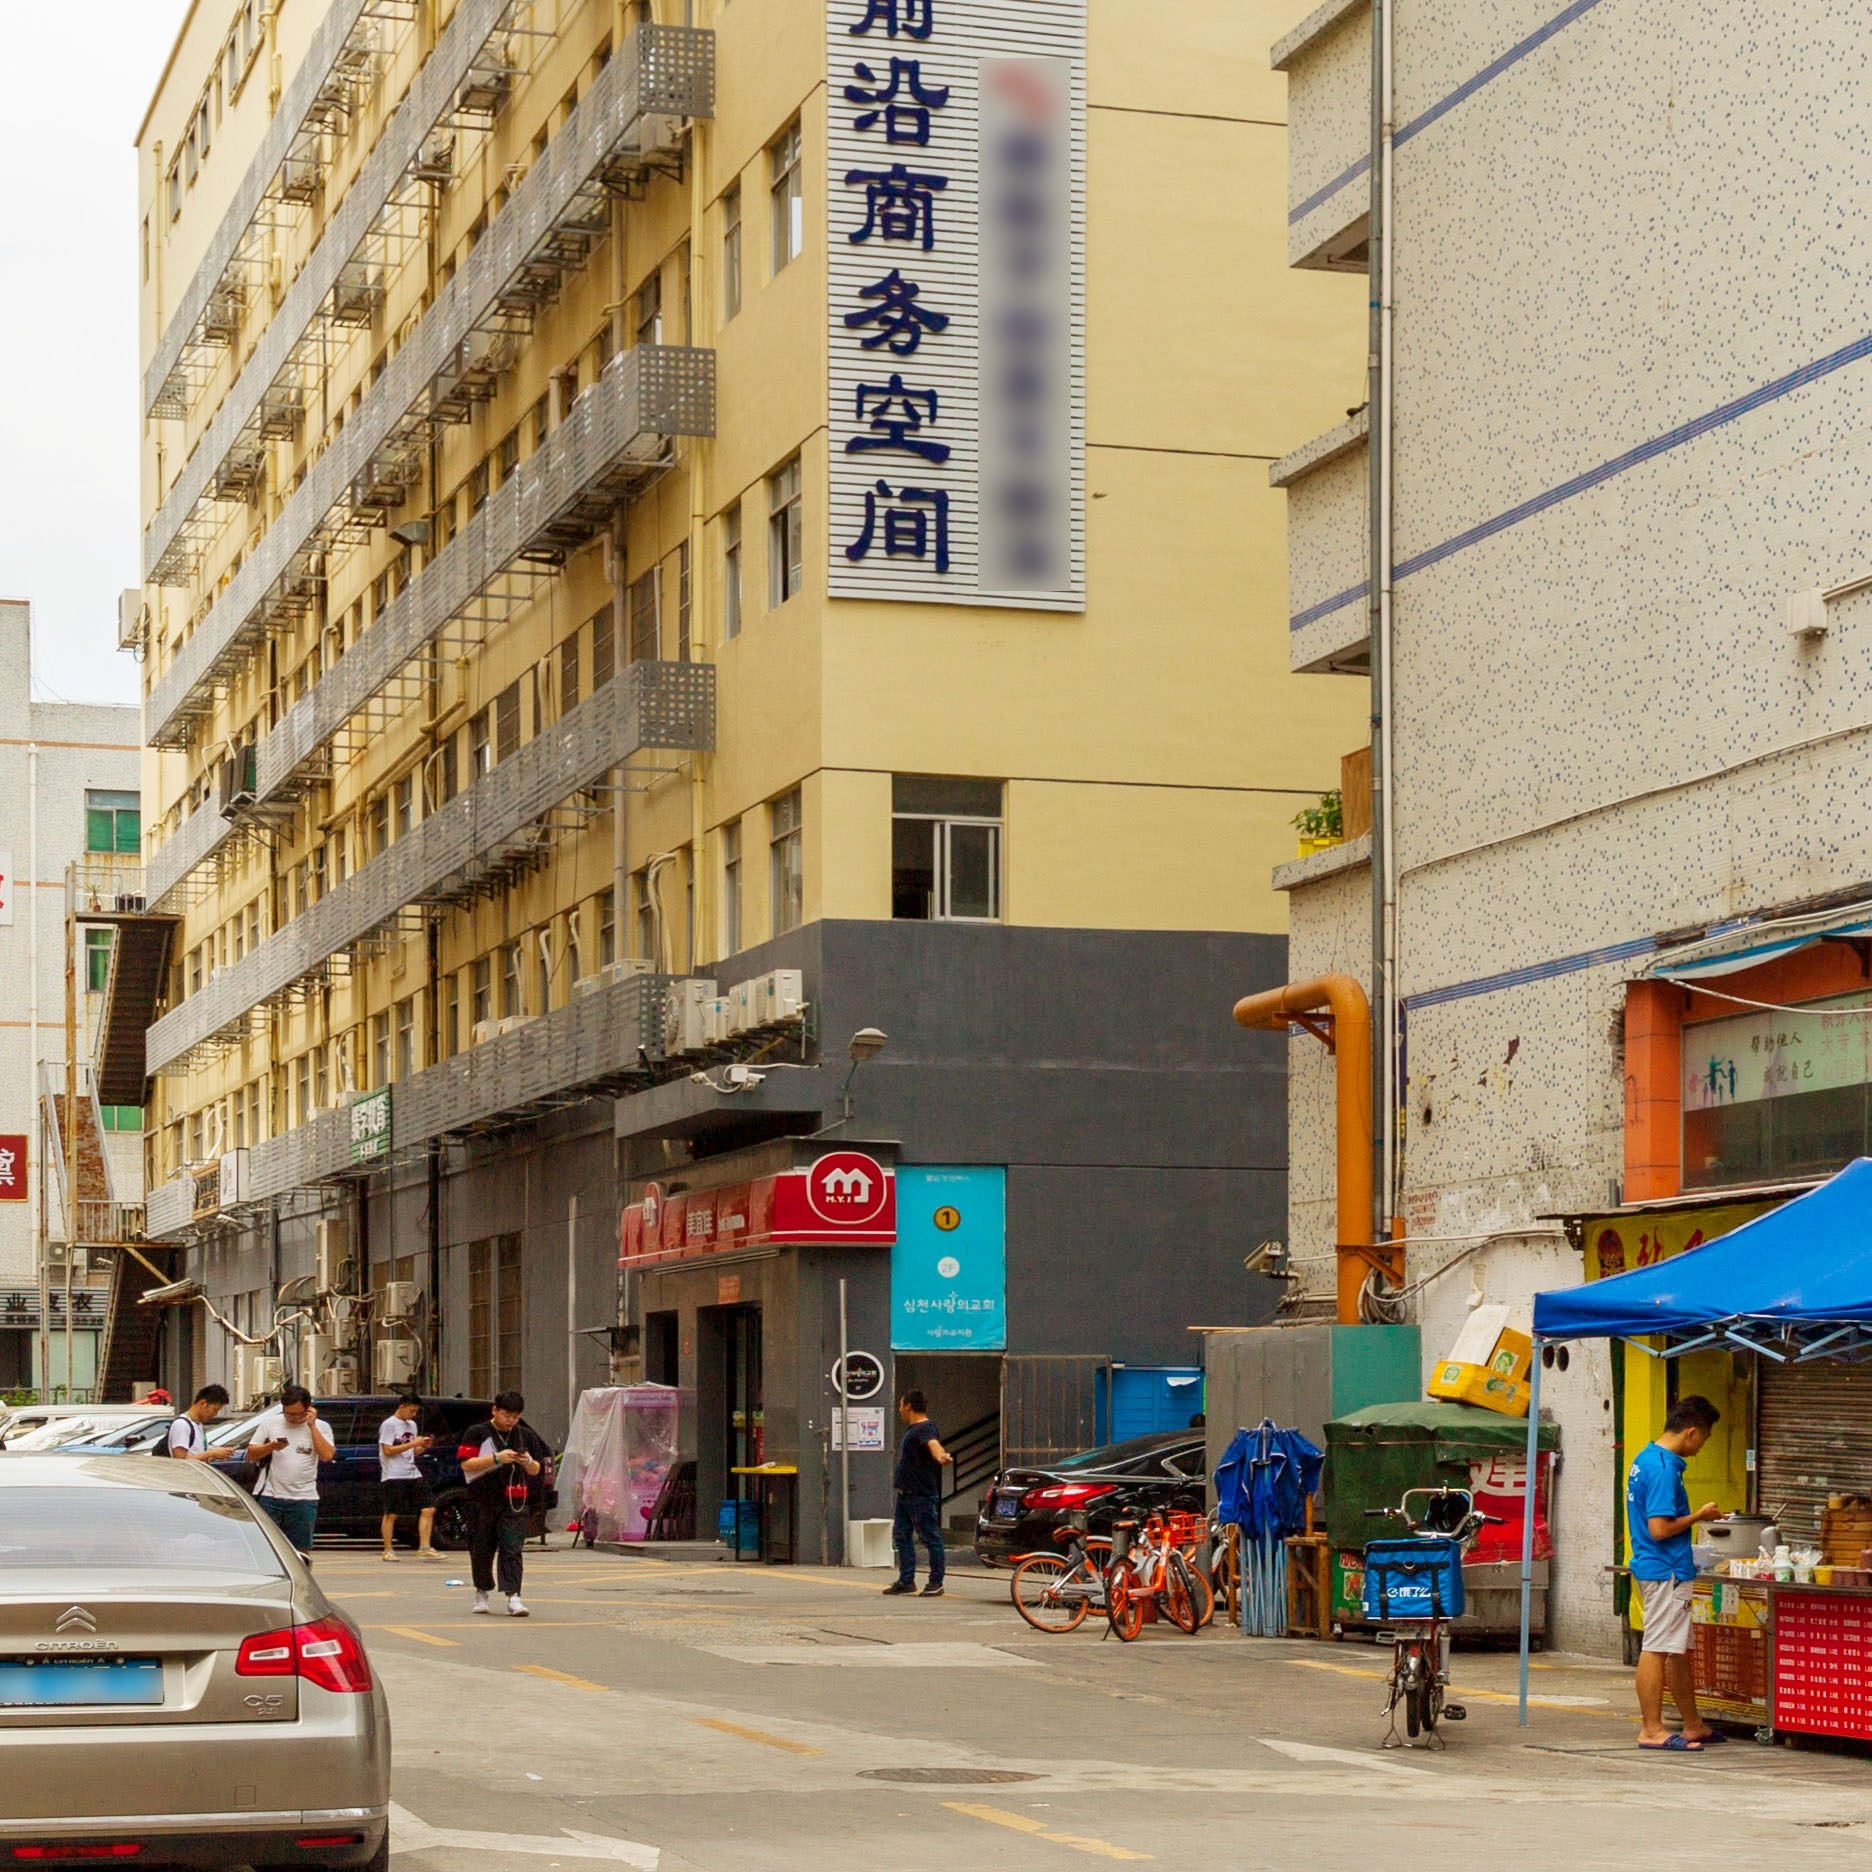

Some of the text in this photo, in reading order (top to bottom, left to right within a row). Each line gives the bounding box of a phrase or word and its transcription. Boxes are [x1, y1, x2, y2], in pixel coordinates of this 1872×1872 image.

[688, 1210, 713, 1236] 美宜佳
[942, 1211, 951, 1225] 1
[942, 1263, 955, 1273] 2F
[1399, 1586, 1432, 1598] 饿了么
[243, 1694, 284, 1707] C5
